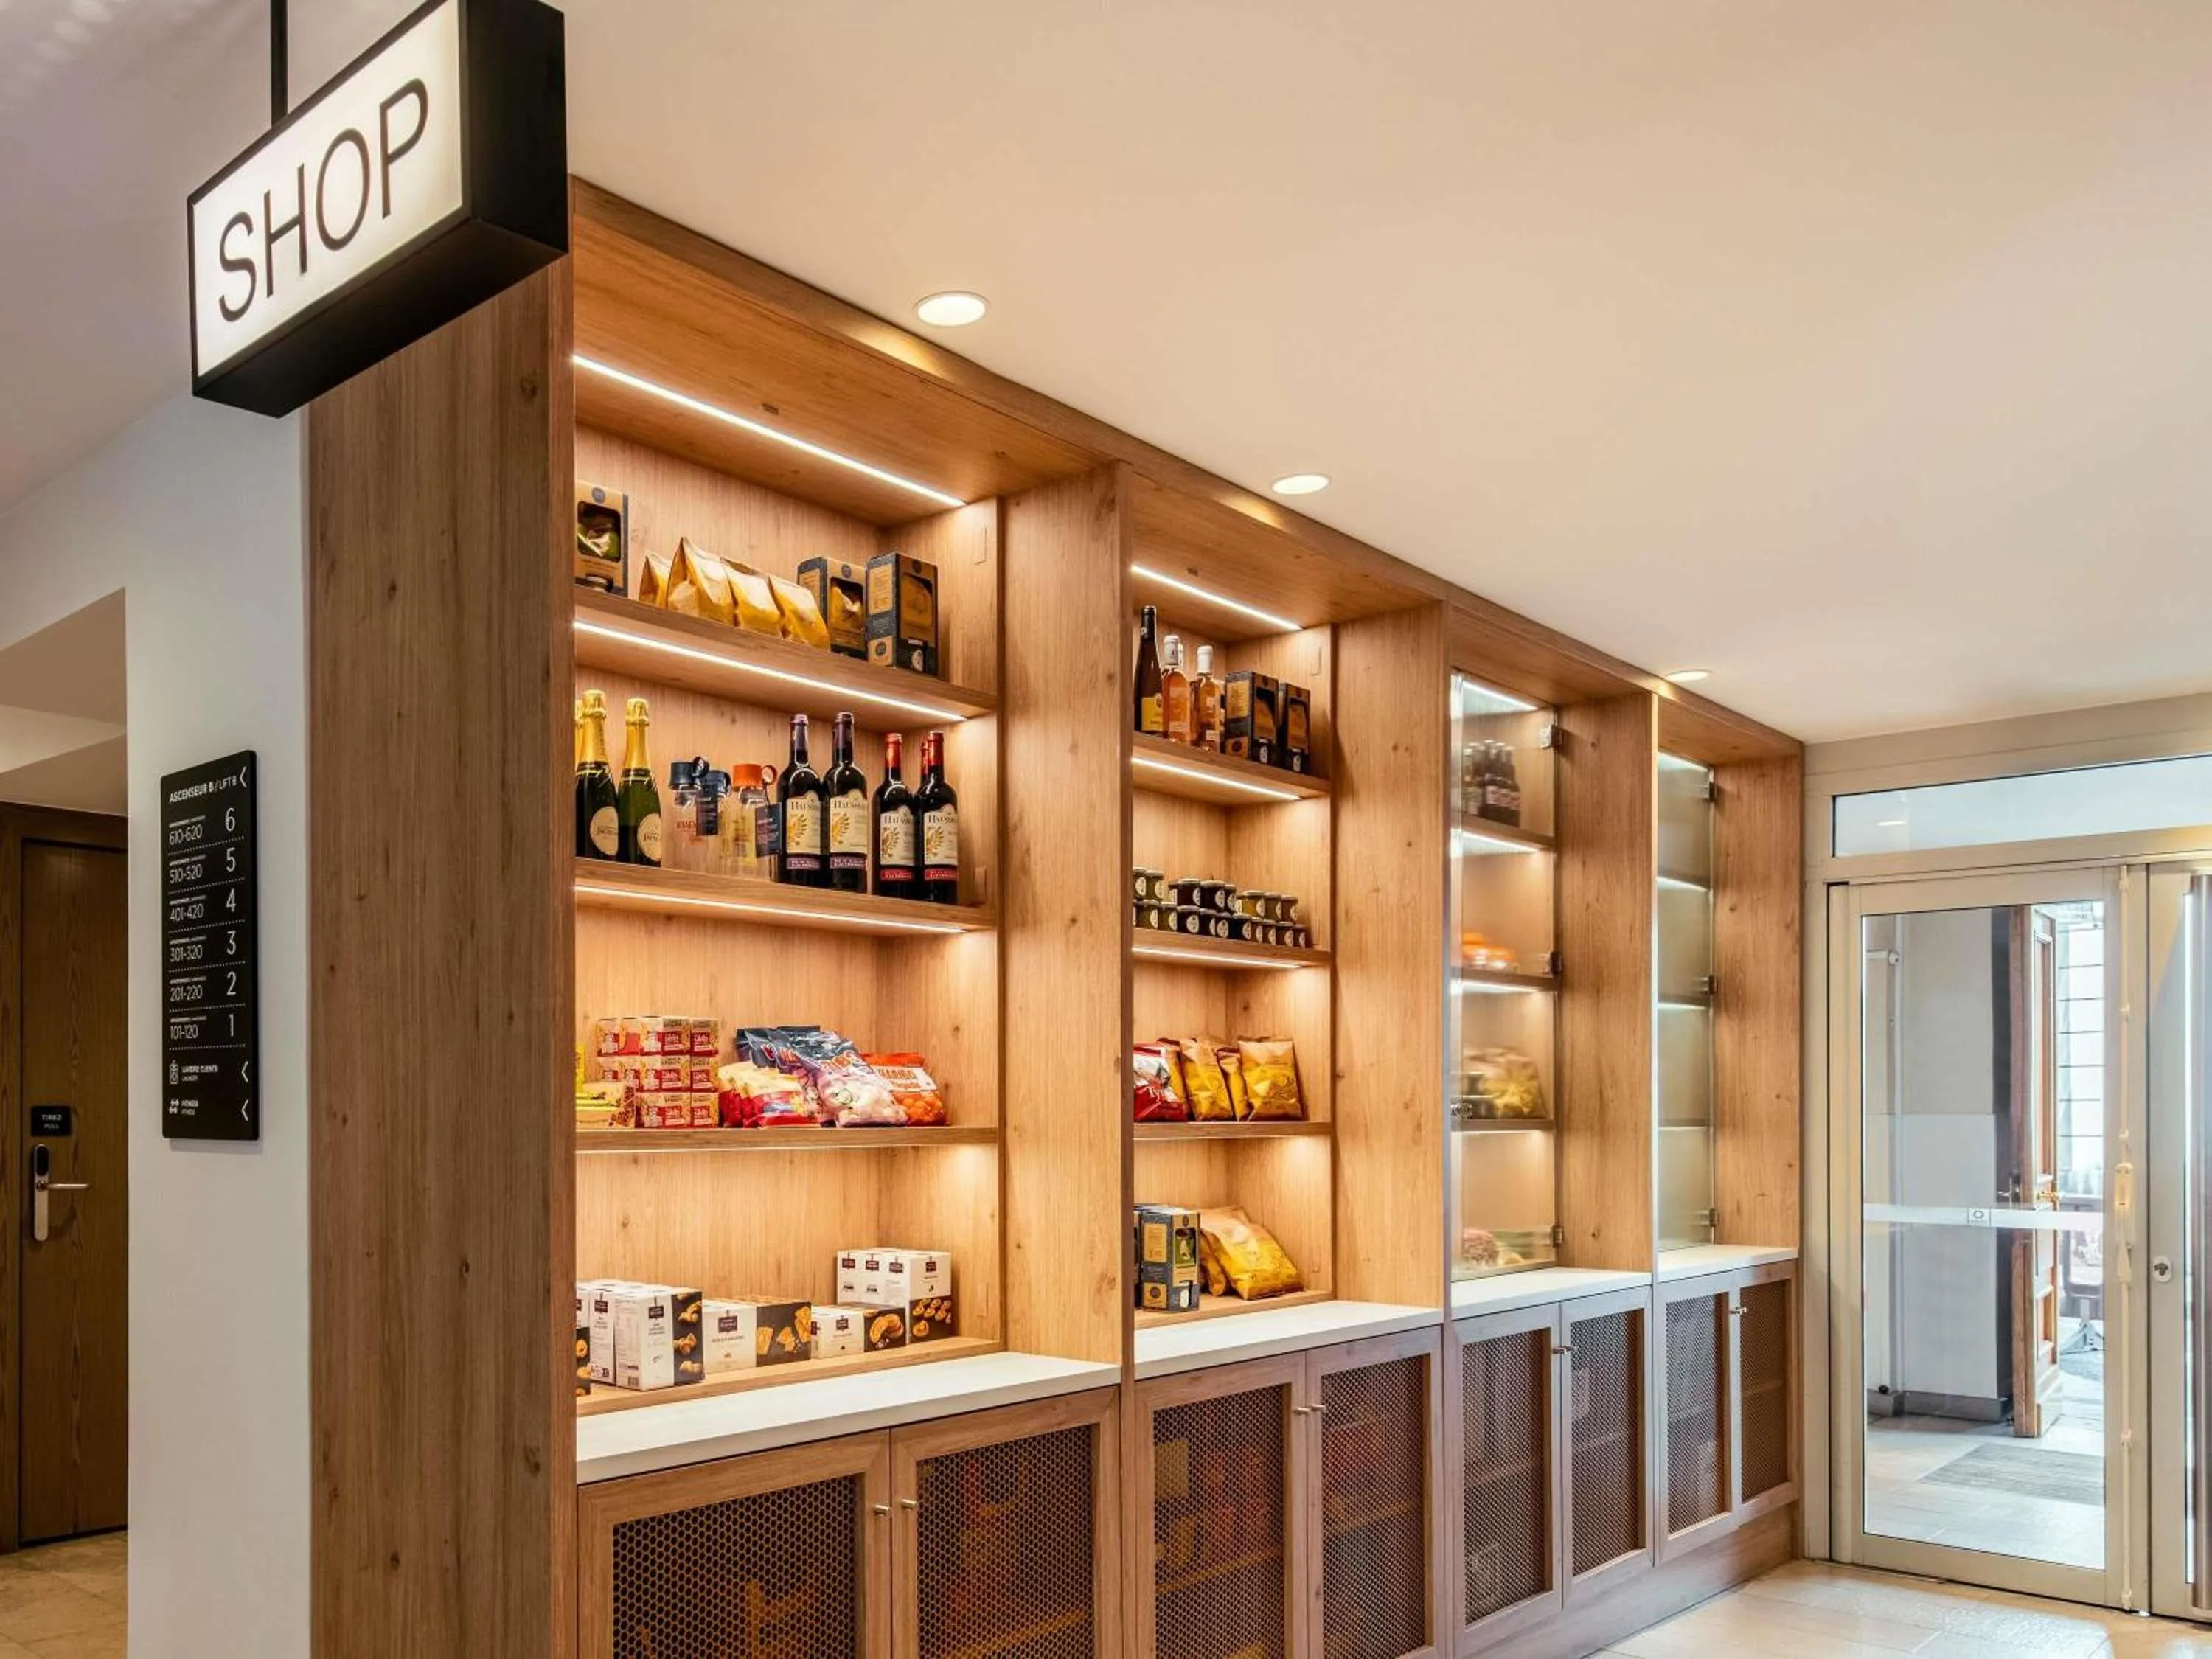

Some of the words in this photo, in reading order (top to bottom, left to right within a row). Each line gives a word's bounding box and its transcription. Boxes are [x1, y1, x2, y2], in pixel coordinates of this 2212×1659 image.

[219, 77, 428, 322] SHOP
[169, 782, 206, 803] ASCENSEUR
[225, 807, 235, 832] 6
[169, 824, 203, 846] 610-620
[226, 847, 236, 872] 5
[169, 863, 203, 884] 510-520
[226, 888, 237, 913] 4
[170, 903, 204, 922] 401-420
[170, 945, 203, 962] 301-320
[226, 931, 237, 955] 3
[170, 985, 203, 1002] 201-220
[226, 971, 237, 995] 2
[170, 1024, 198, 1039] 101-120
[228, 1014, 234, 1037] 1
